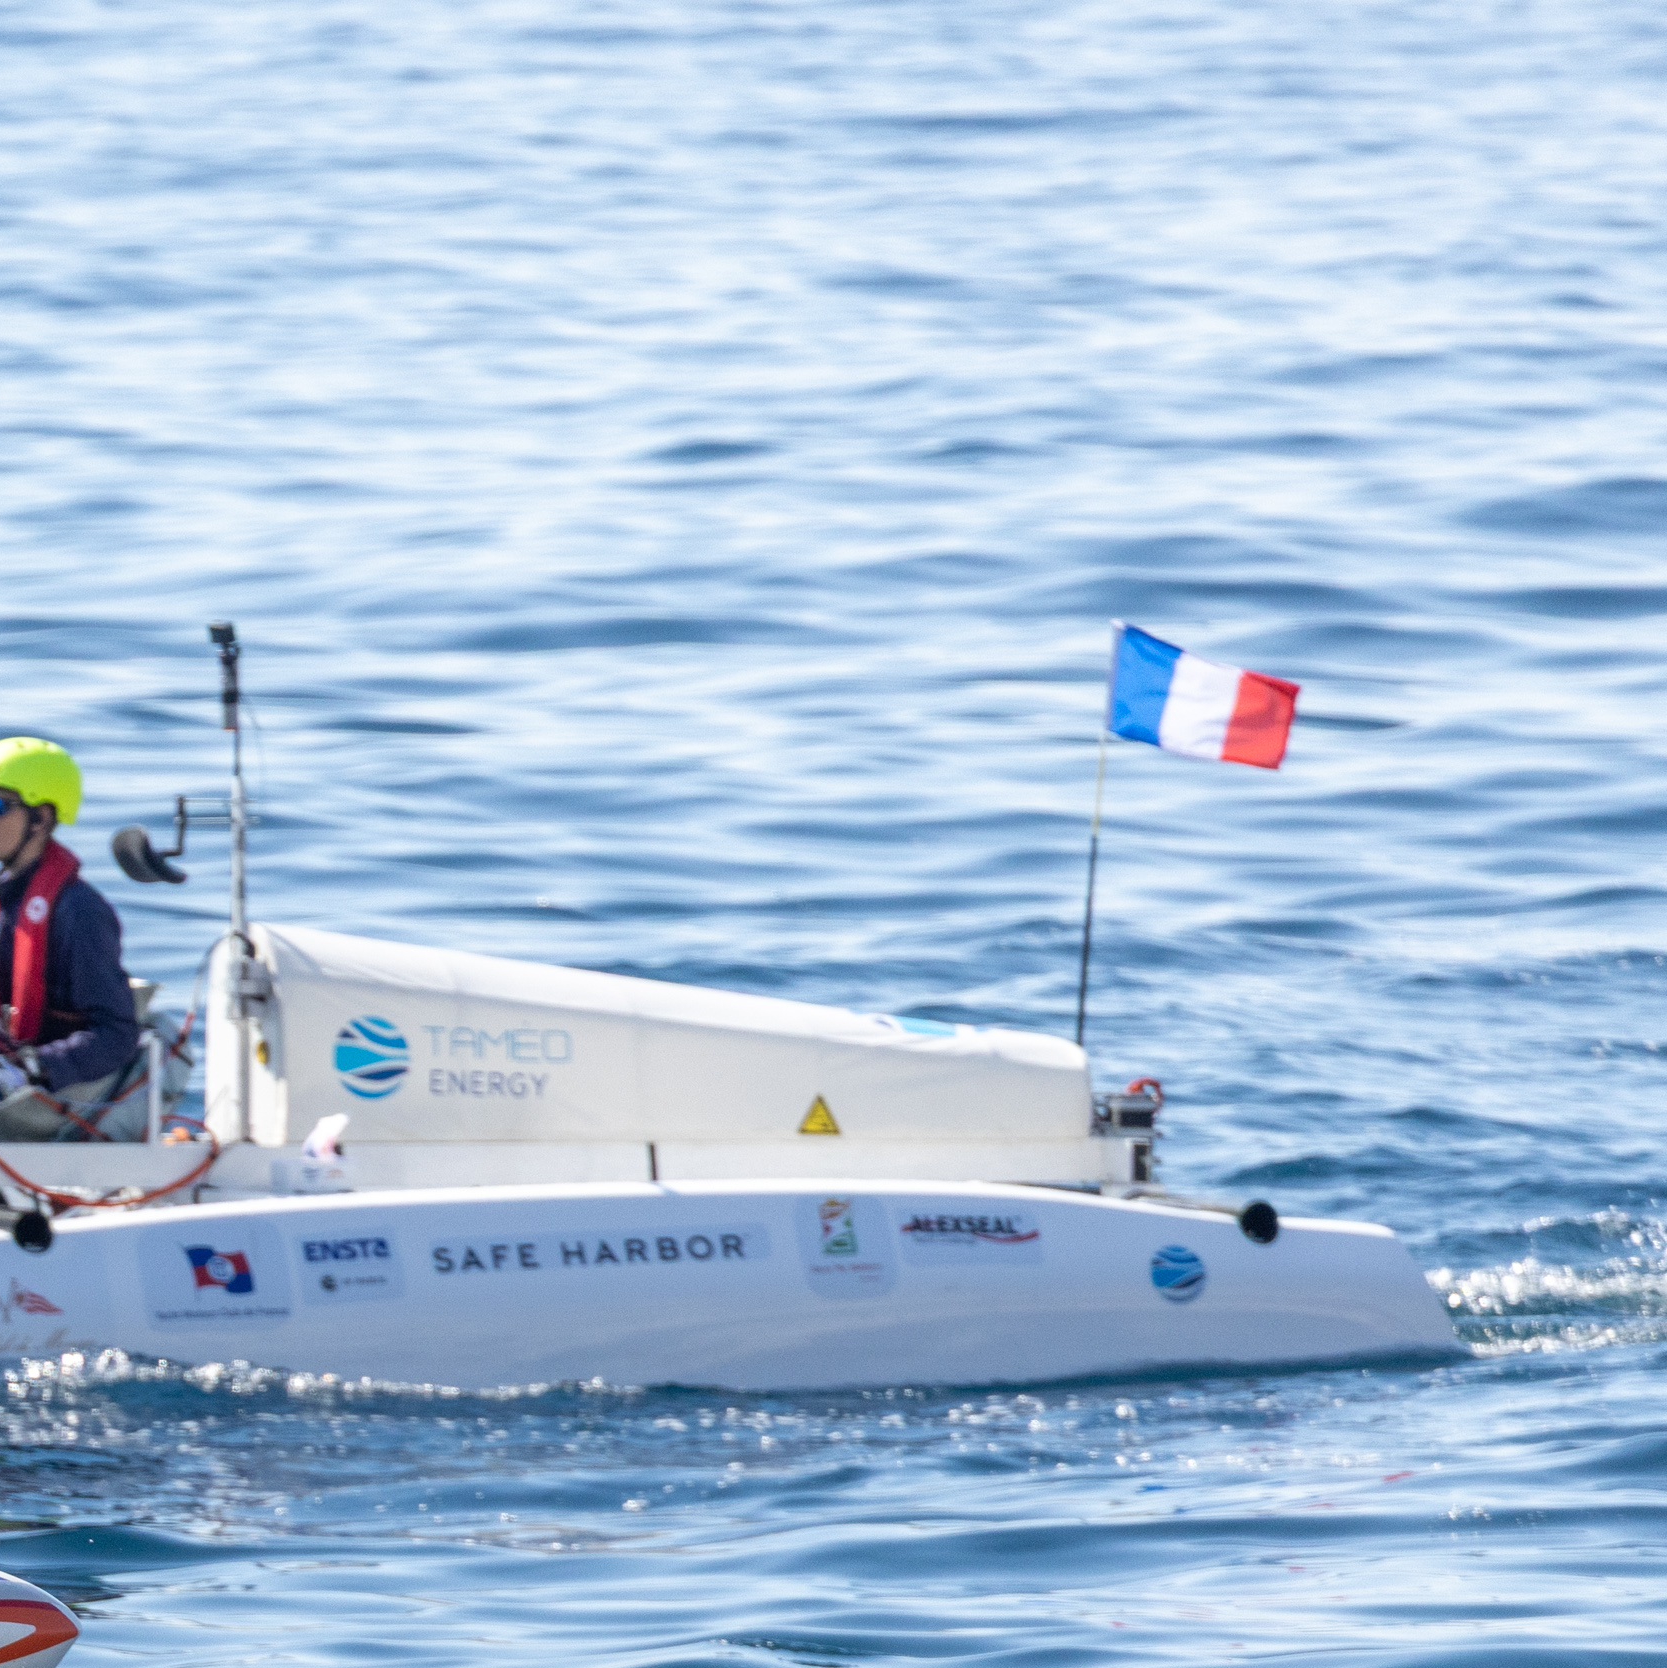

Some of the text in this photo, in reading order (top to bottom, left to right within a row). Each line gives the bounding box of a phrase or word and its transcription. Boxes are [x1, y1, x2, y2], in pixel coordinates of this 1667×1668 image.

[429, 1069, 549, 1097] ENERGY
[910, 1214, 1018, 1235] ALEXSEAL
[433, 1234, 746, 1275] SAFE HARBOR
